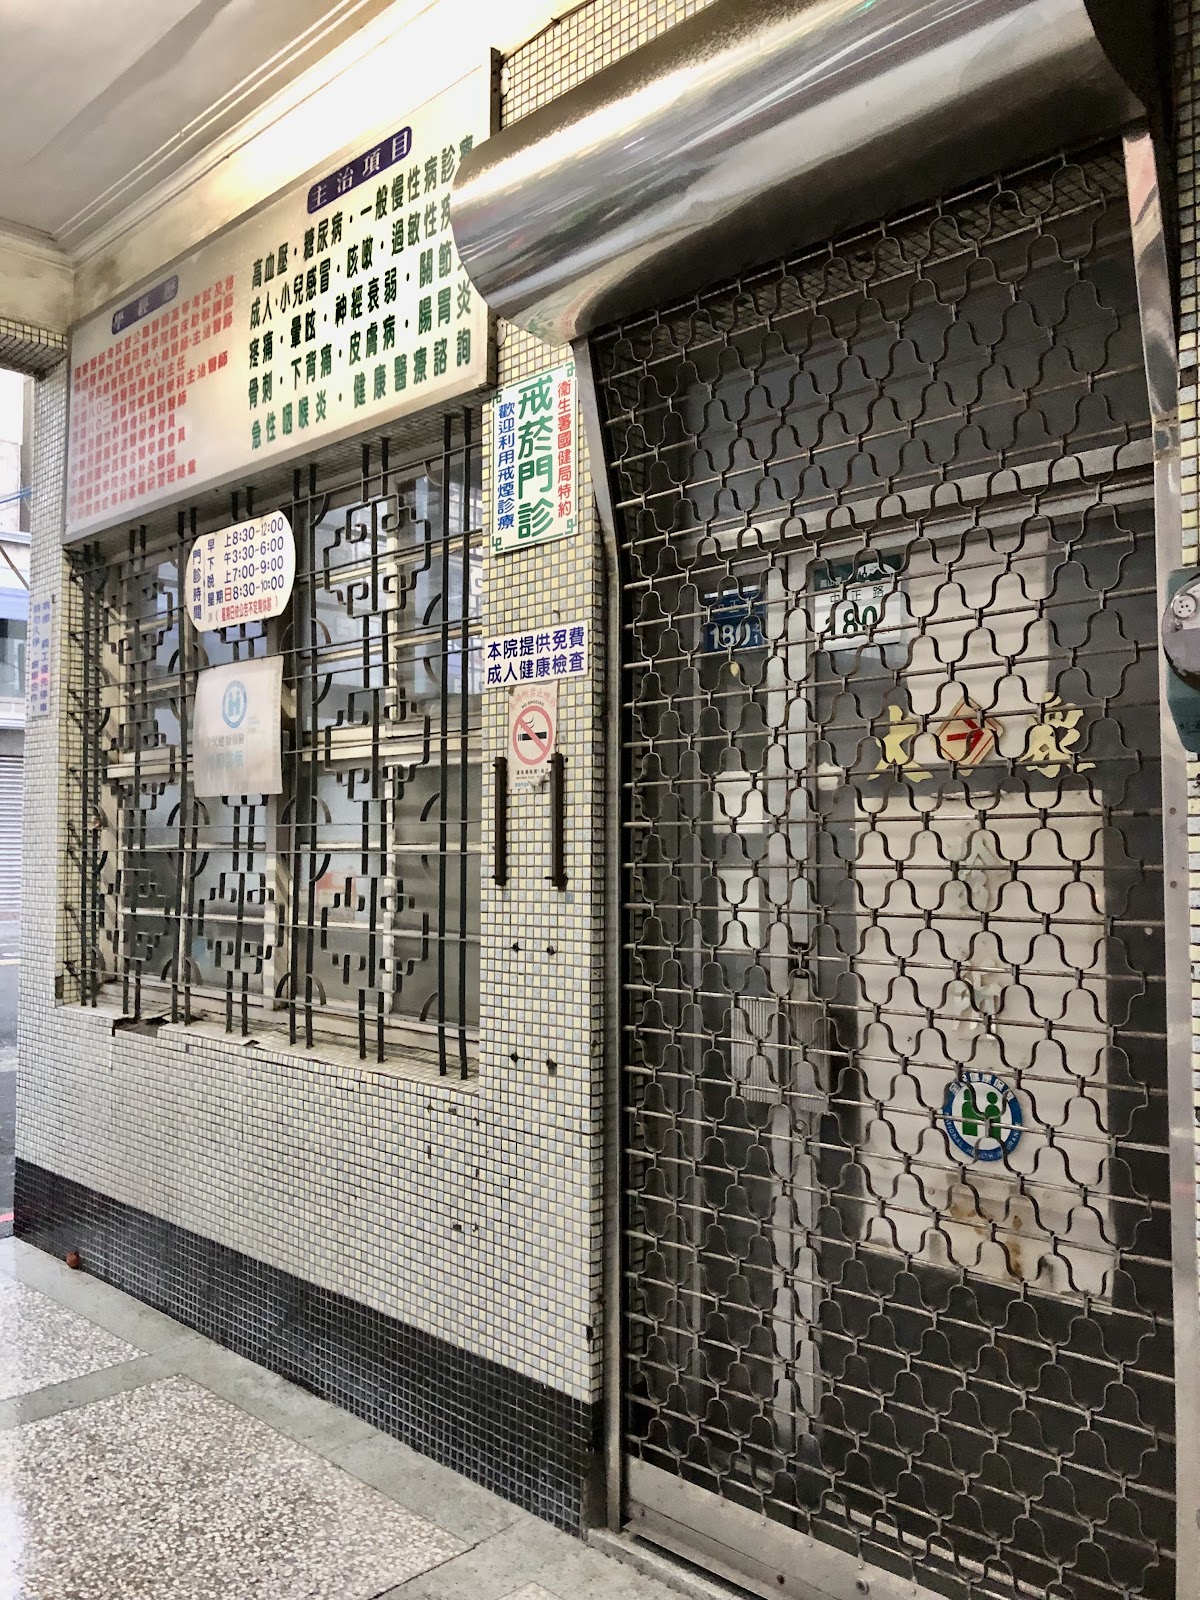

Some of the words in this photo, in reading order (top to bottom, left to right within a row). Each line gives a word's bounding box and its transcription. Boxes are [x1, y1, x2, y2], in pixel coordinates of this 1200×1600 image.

[310, 130, 409, 209] 主治項目
[249, 240, 465, 369] 疼痛·暈眩·神經衰弱·關節
[497, 401, 516, 531] 歡迎利用戒煙診療
[518, 374, 554, 539] 戒菸門診
[557, 379, 572, 518] 衛生署國健局特約
[192, 548, 202, 621] 門診時間
[825, 605, 878, 641] 180
[487, 626, 585, 661] 本院提供免費
[487, 651, 585, 685] 成人健康檢查
